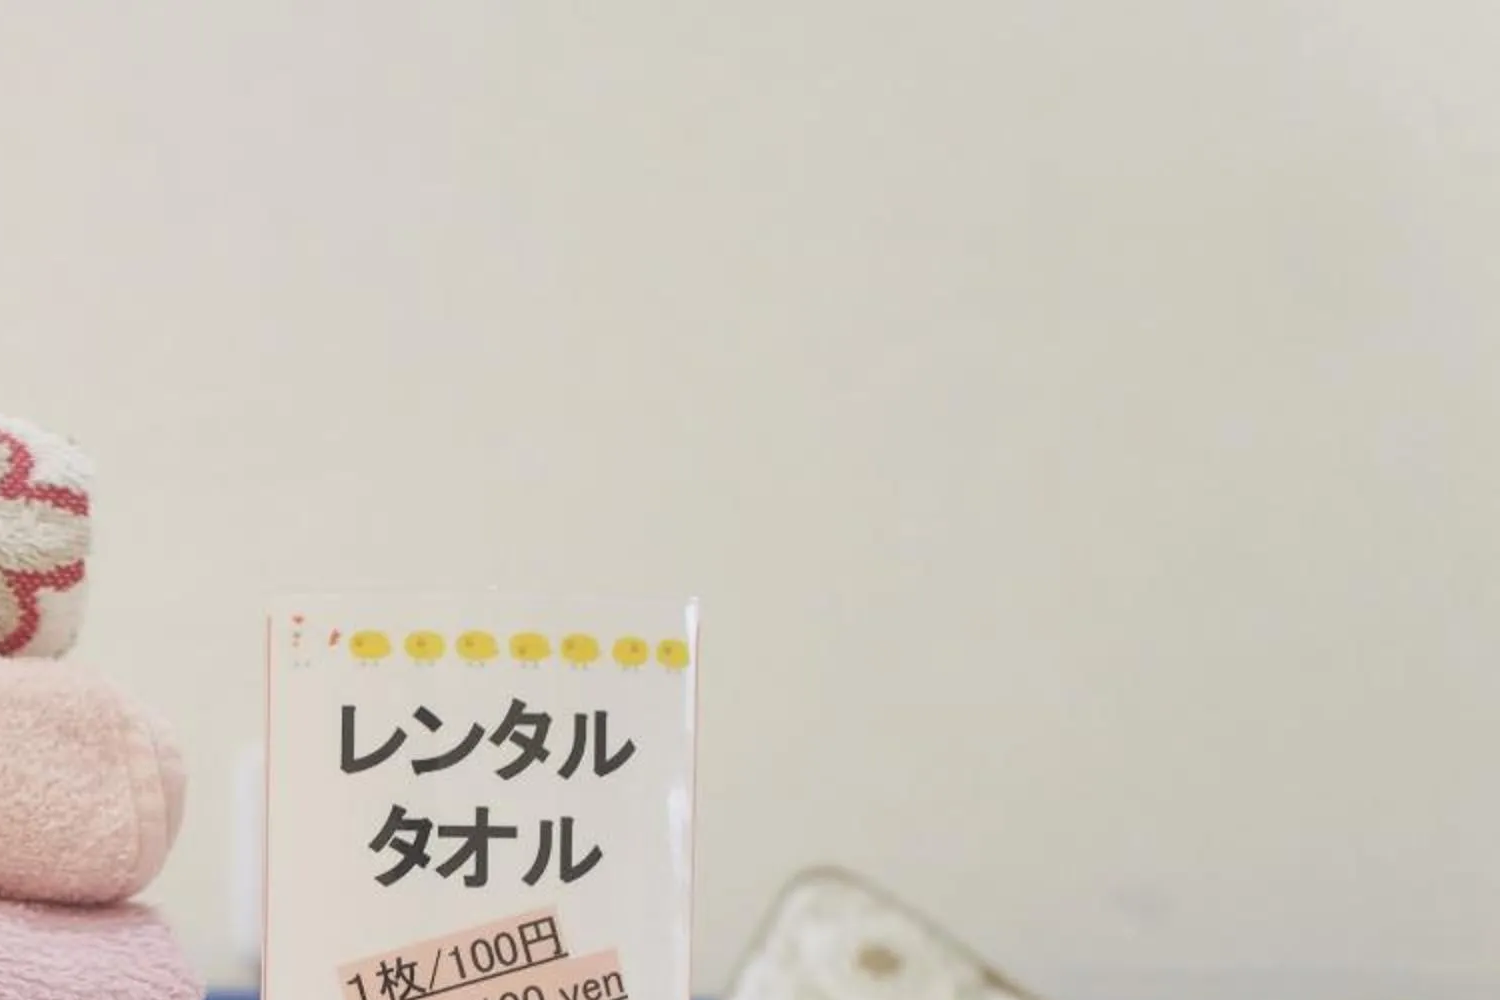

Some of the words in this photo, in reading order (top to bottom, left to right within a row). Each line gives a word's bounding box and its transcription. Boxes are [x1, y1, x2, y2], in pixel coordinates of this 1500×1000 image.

[340, 698, 636, 780] レンタル
[368, 804, 603, 888] タオル
